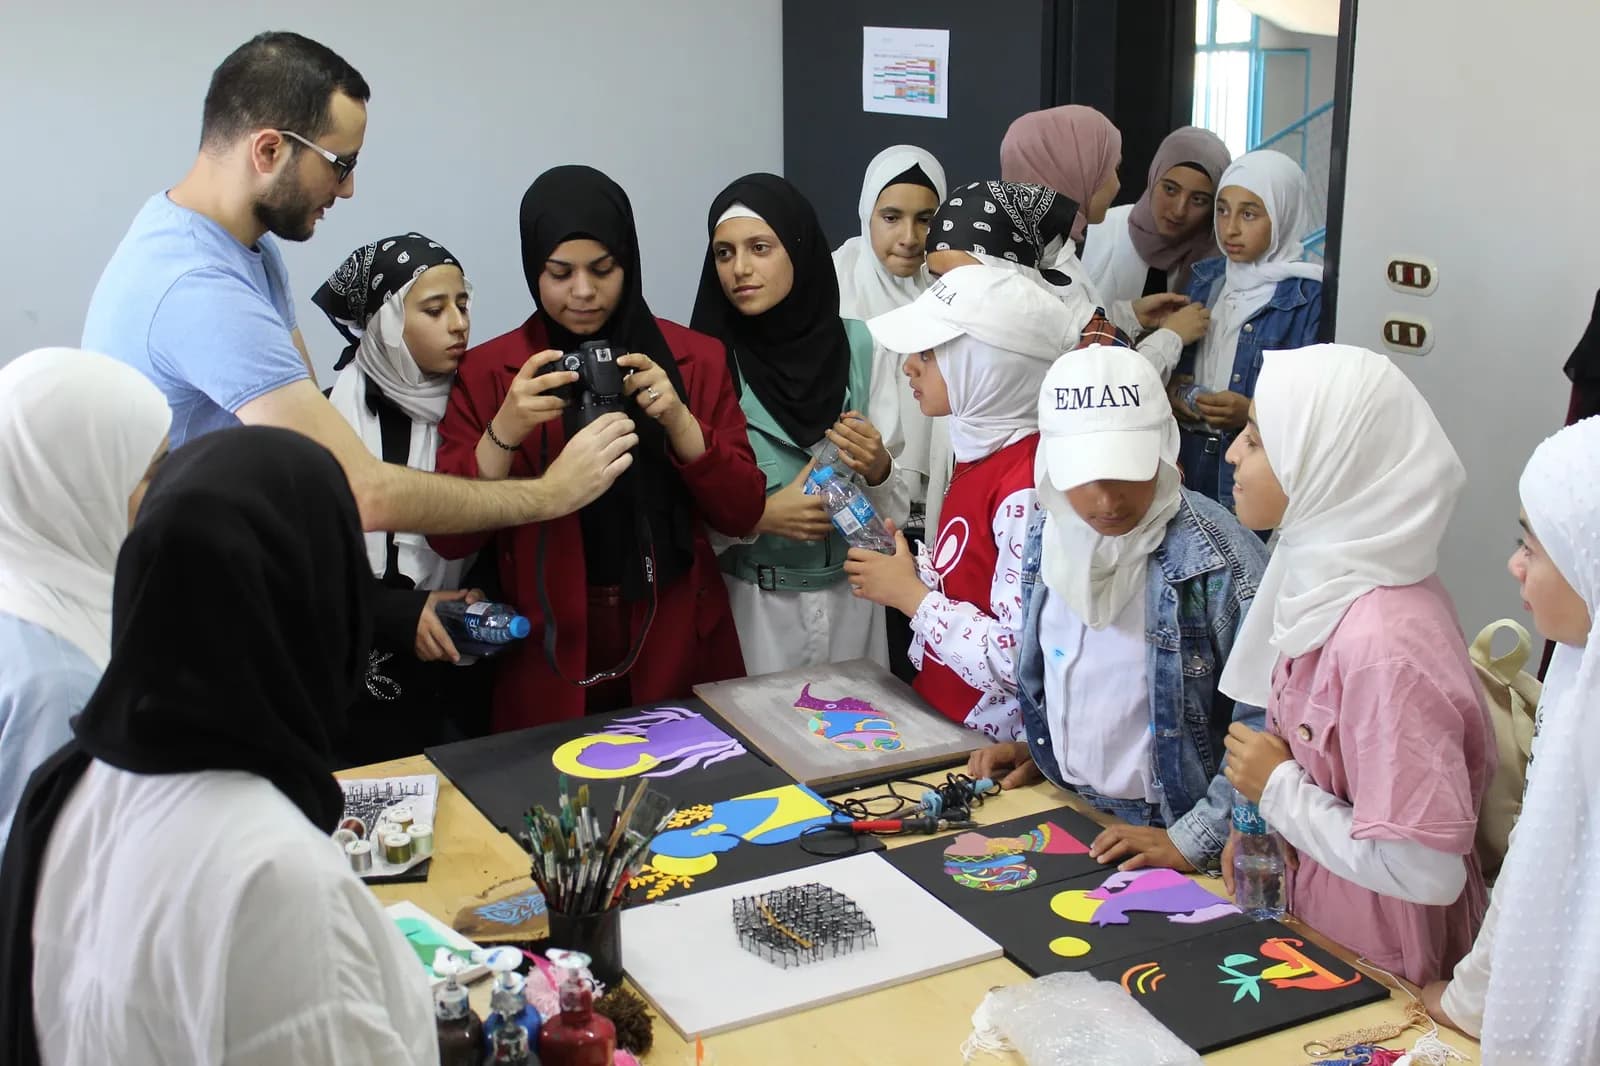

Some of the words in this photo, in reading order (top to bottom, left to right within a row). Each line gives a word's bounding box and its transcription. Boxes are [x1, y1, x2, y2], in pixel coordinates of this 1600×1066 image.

[1054, 384, 1140, 410] EMAN
[1005, 504, 1024, 518] 13
[997, 633, 1017, 649] 15
[989, 696, 1007, 705] 24
